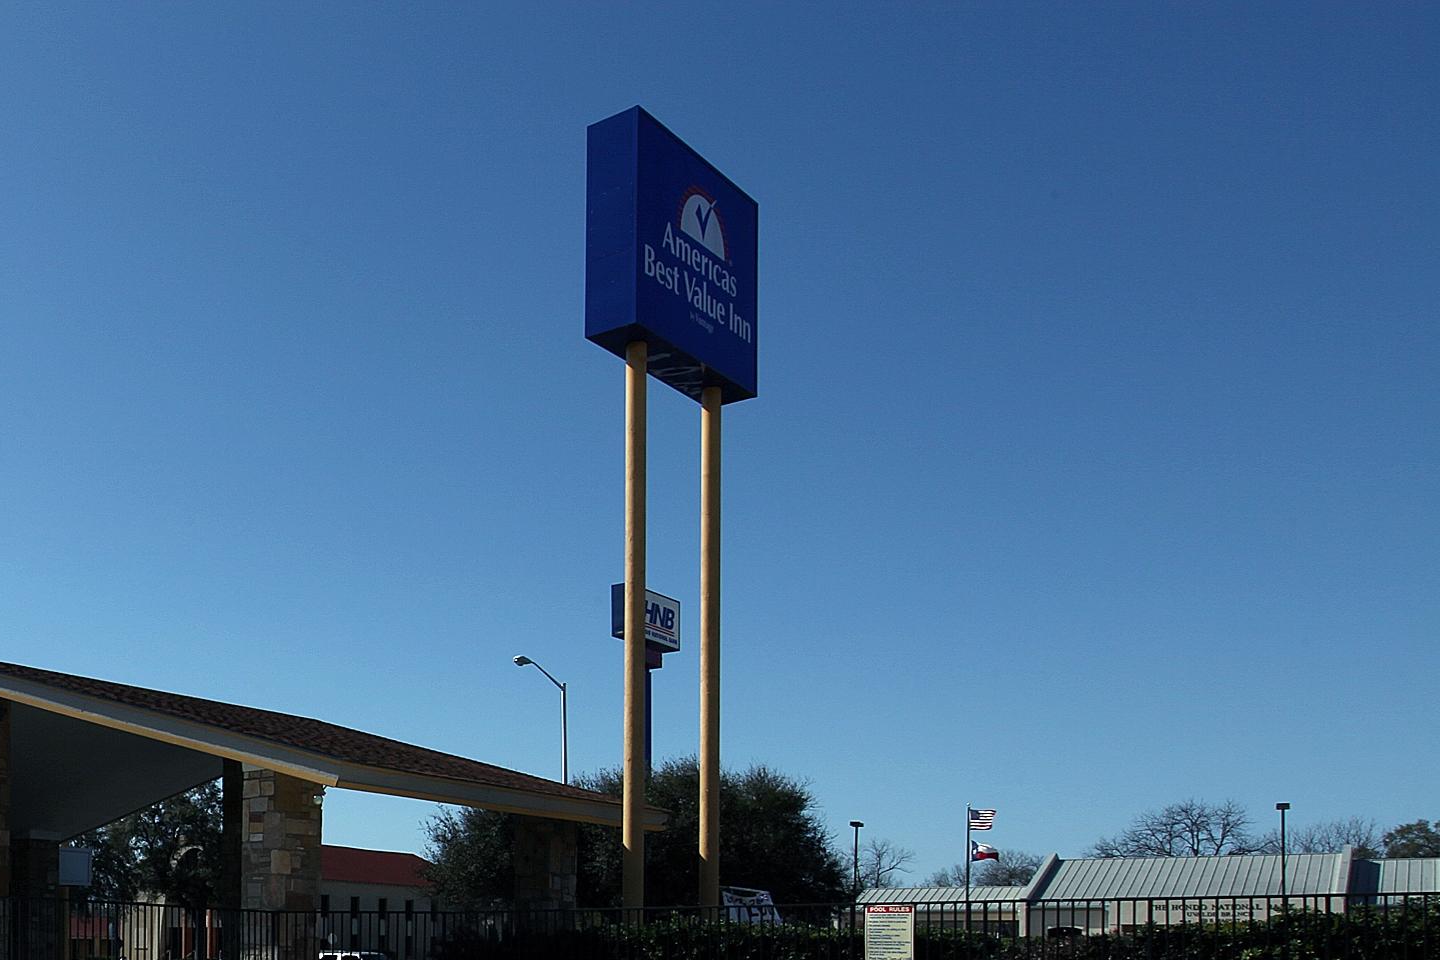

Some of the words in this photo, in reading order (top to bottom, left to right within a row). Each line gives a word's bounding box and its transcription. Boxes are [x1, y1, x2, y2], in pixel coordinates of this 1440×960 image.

[662, 221, 737, 298] Americas
[644, 244, 680, 296] Best
[683, 271, 726, 325] Value
[728, 302, 752, 344] Inn
[645, 600, 675, 630] HNB
[1211, 903, 1263, 911] NATONL
